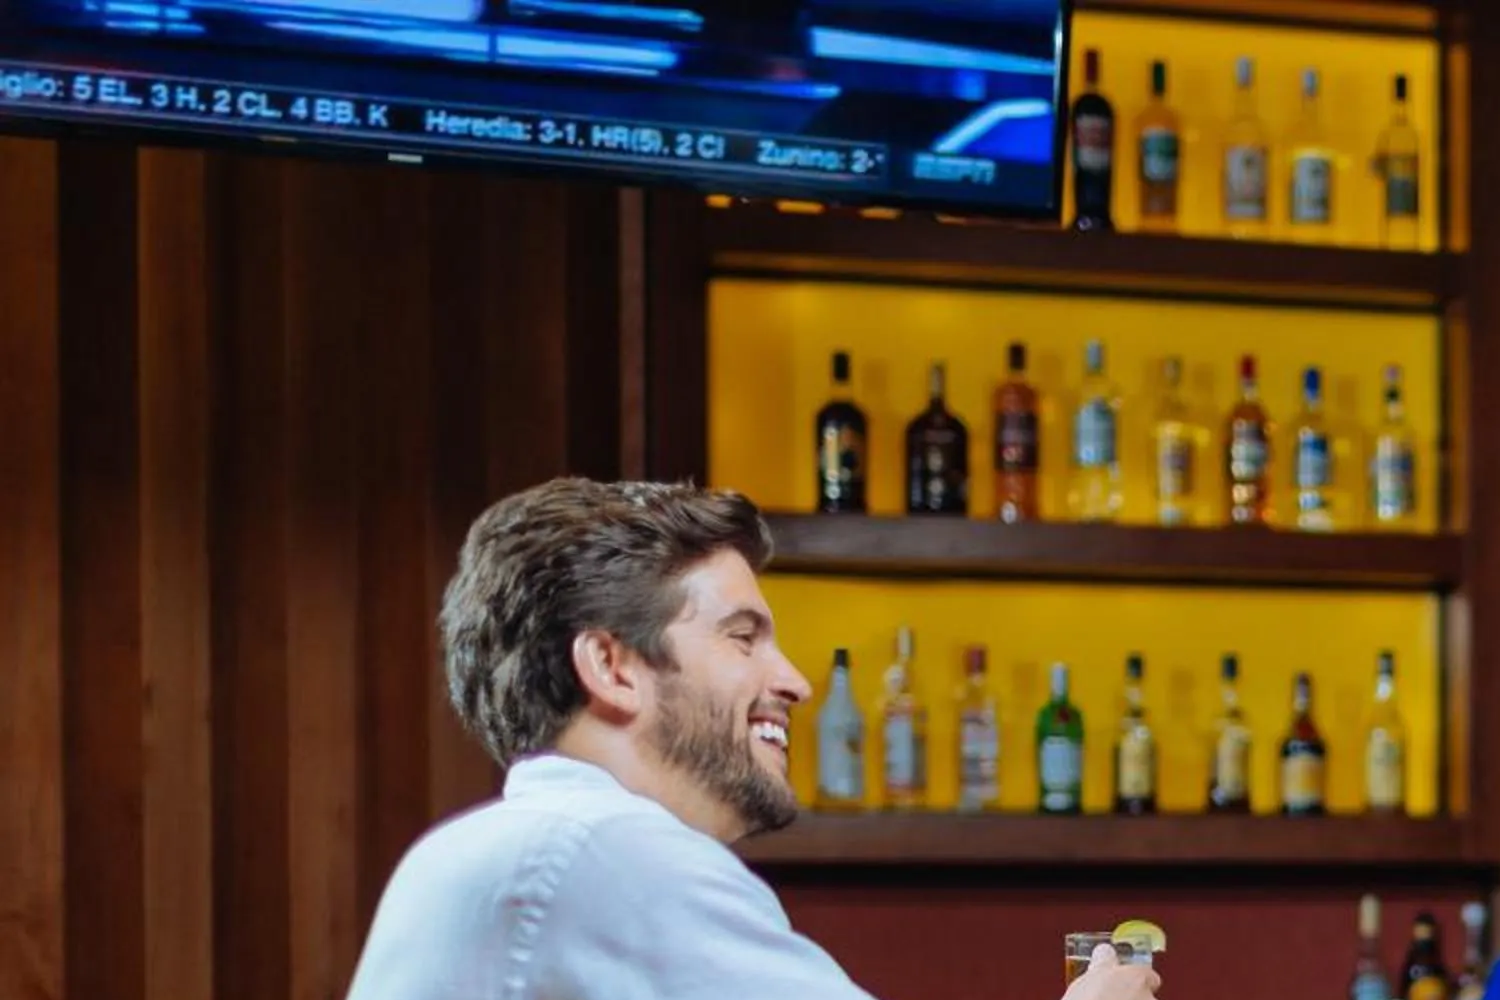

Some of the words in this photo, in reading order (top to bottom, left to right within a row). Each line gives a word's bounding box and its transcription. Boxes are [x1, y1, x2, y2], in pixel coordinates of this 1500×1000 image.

[73, 75, 92, 100] 5
[151, 83, 169, 108] 3
[213, 89, 231, 113] 2
[290, 97, 308, 120] 4
[367, 104, 388, 127] K
[674, 133, 693, 157] 2
